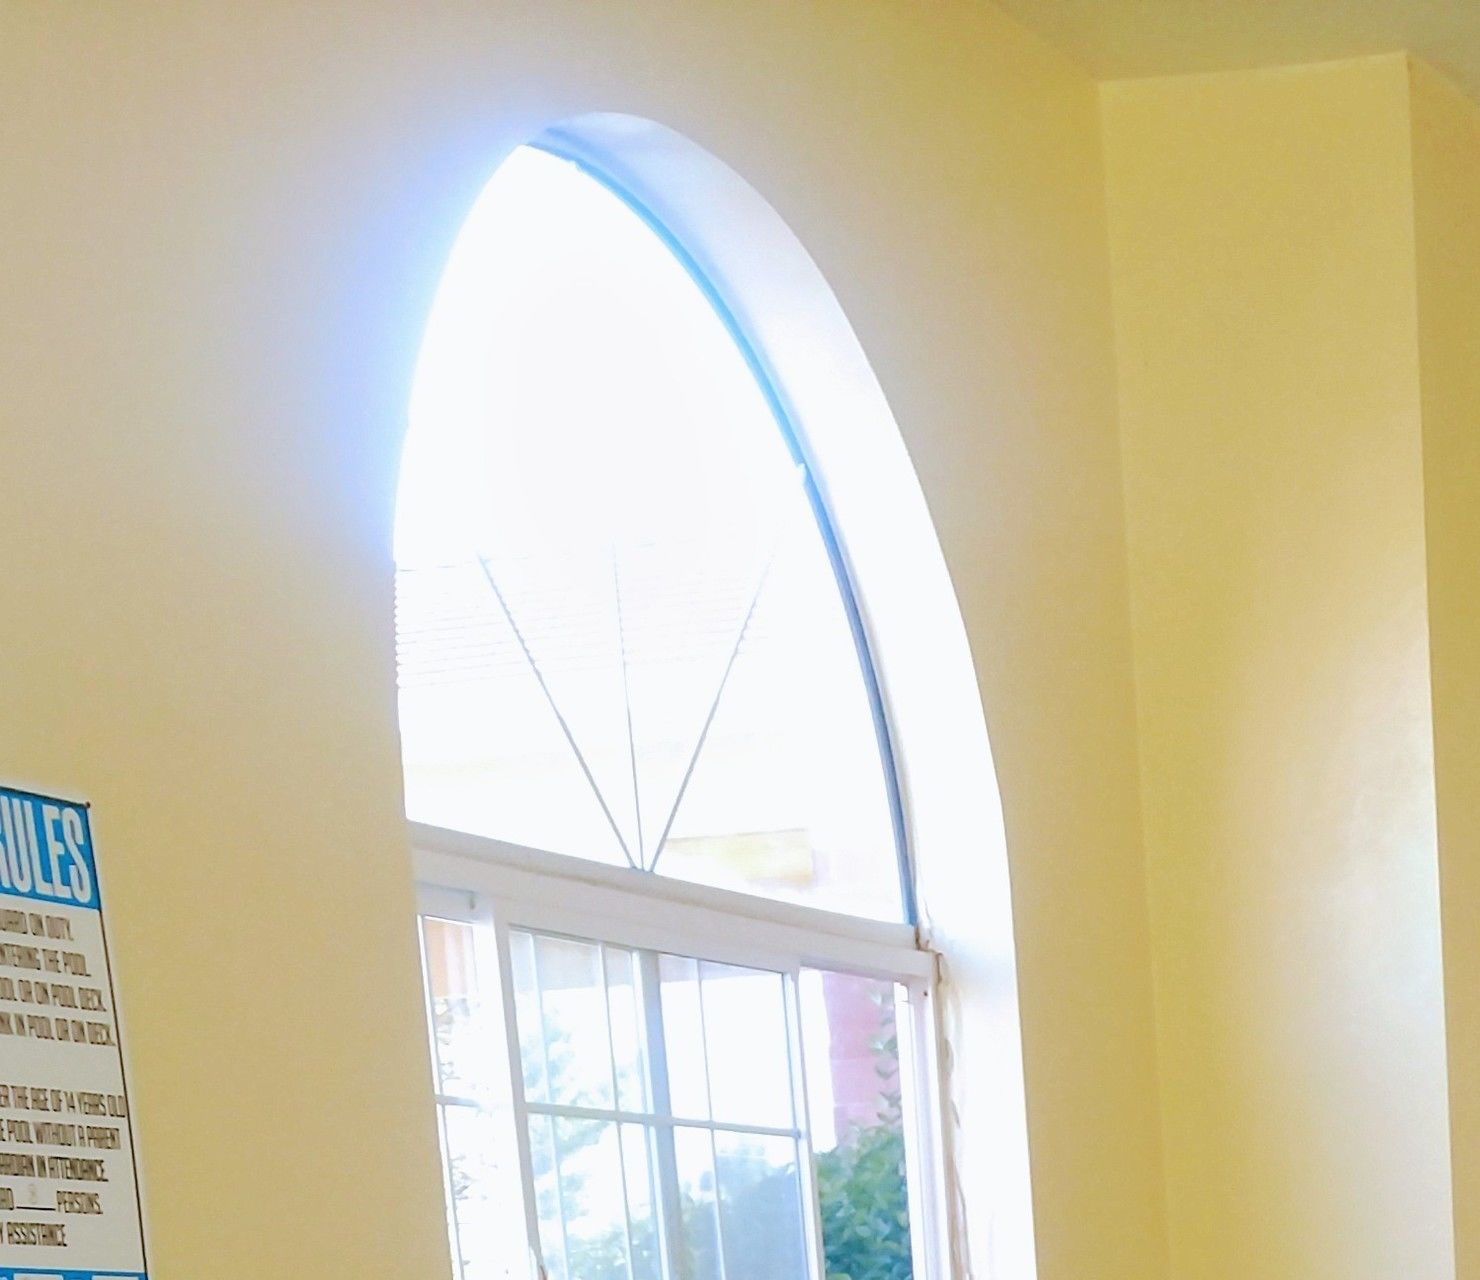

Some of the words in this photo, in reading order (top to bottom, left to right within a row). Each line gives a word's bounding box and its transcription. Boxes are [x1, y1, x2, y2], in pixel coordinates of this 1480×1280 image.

[42, 948, 61, 973] THE
[51, 983, 79, 1010] POOL
[26, 1014, 55, 1041] POOL
[77, 1091, 107, 1116] YEARS
[7, 1118, 33, 1144] POOL
